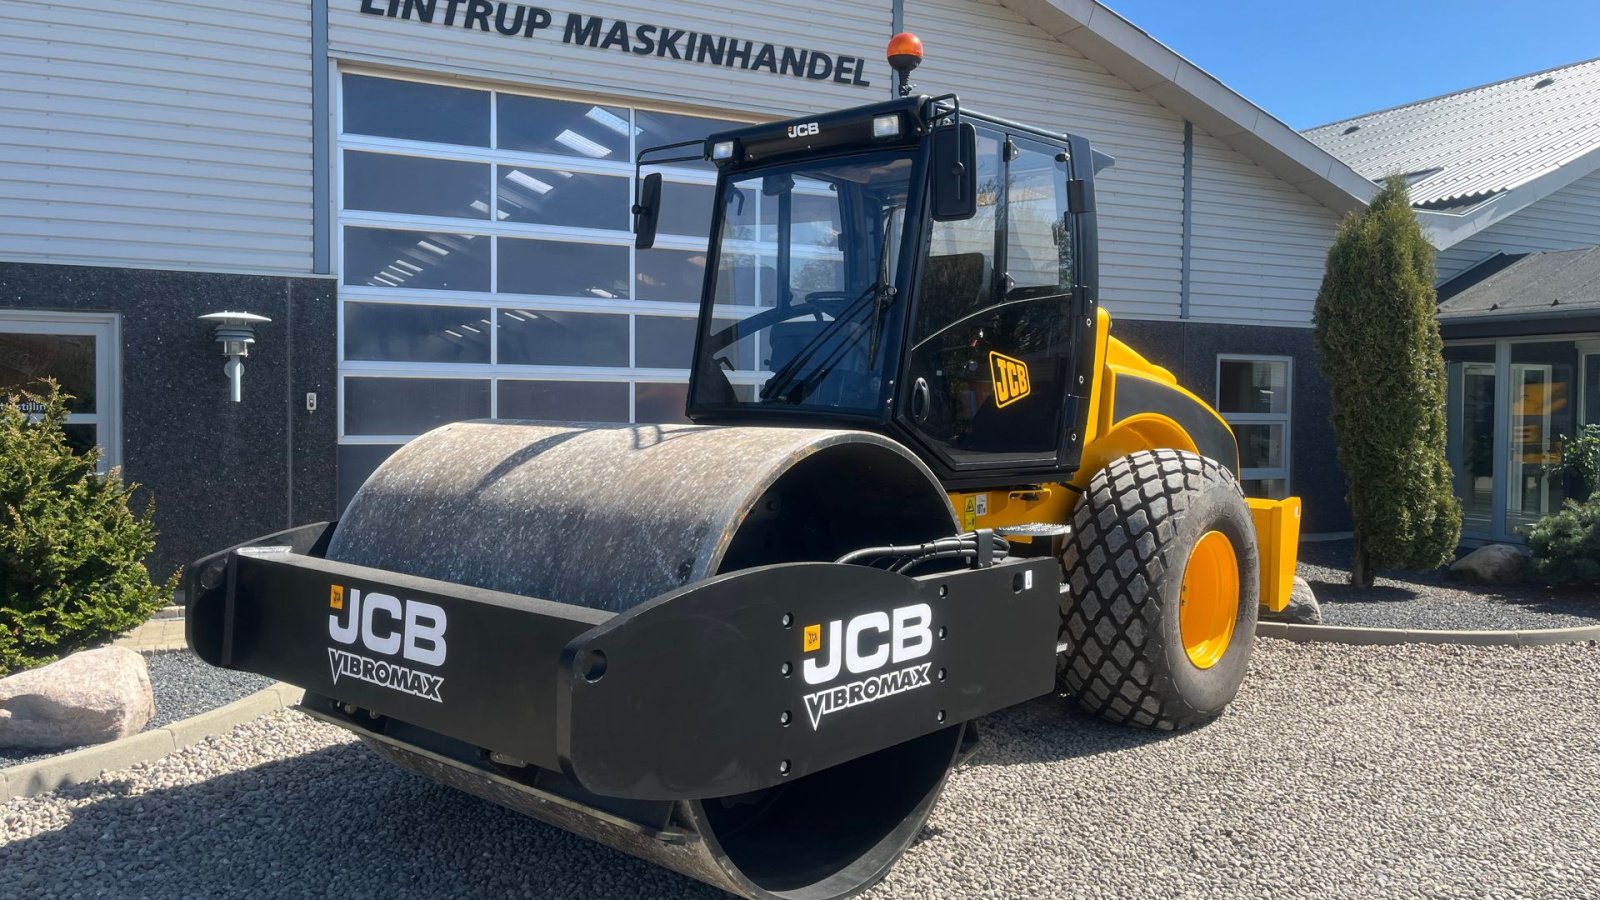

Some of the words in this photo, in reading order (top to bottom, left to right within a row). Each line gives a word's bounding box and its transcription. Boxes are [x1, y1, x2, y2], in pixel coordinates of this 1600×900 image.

[563, 13, 870, 86] MASKINHANDEL
[788, 122, 820, 138] JCB
[996, 357, 1028, 402] JCB
[329, 588, 447, 666] JCB
[803, 603, 933, 685] JCB
[328, 647, 444, 703] VIBROMAX
[803, 662, 932, 731] VIBROMAX
